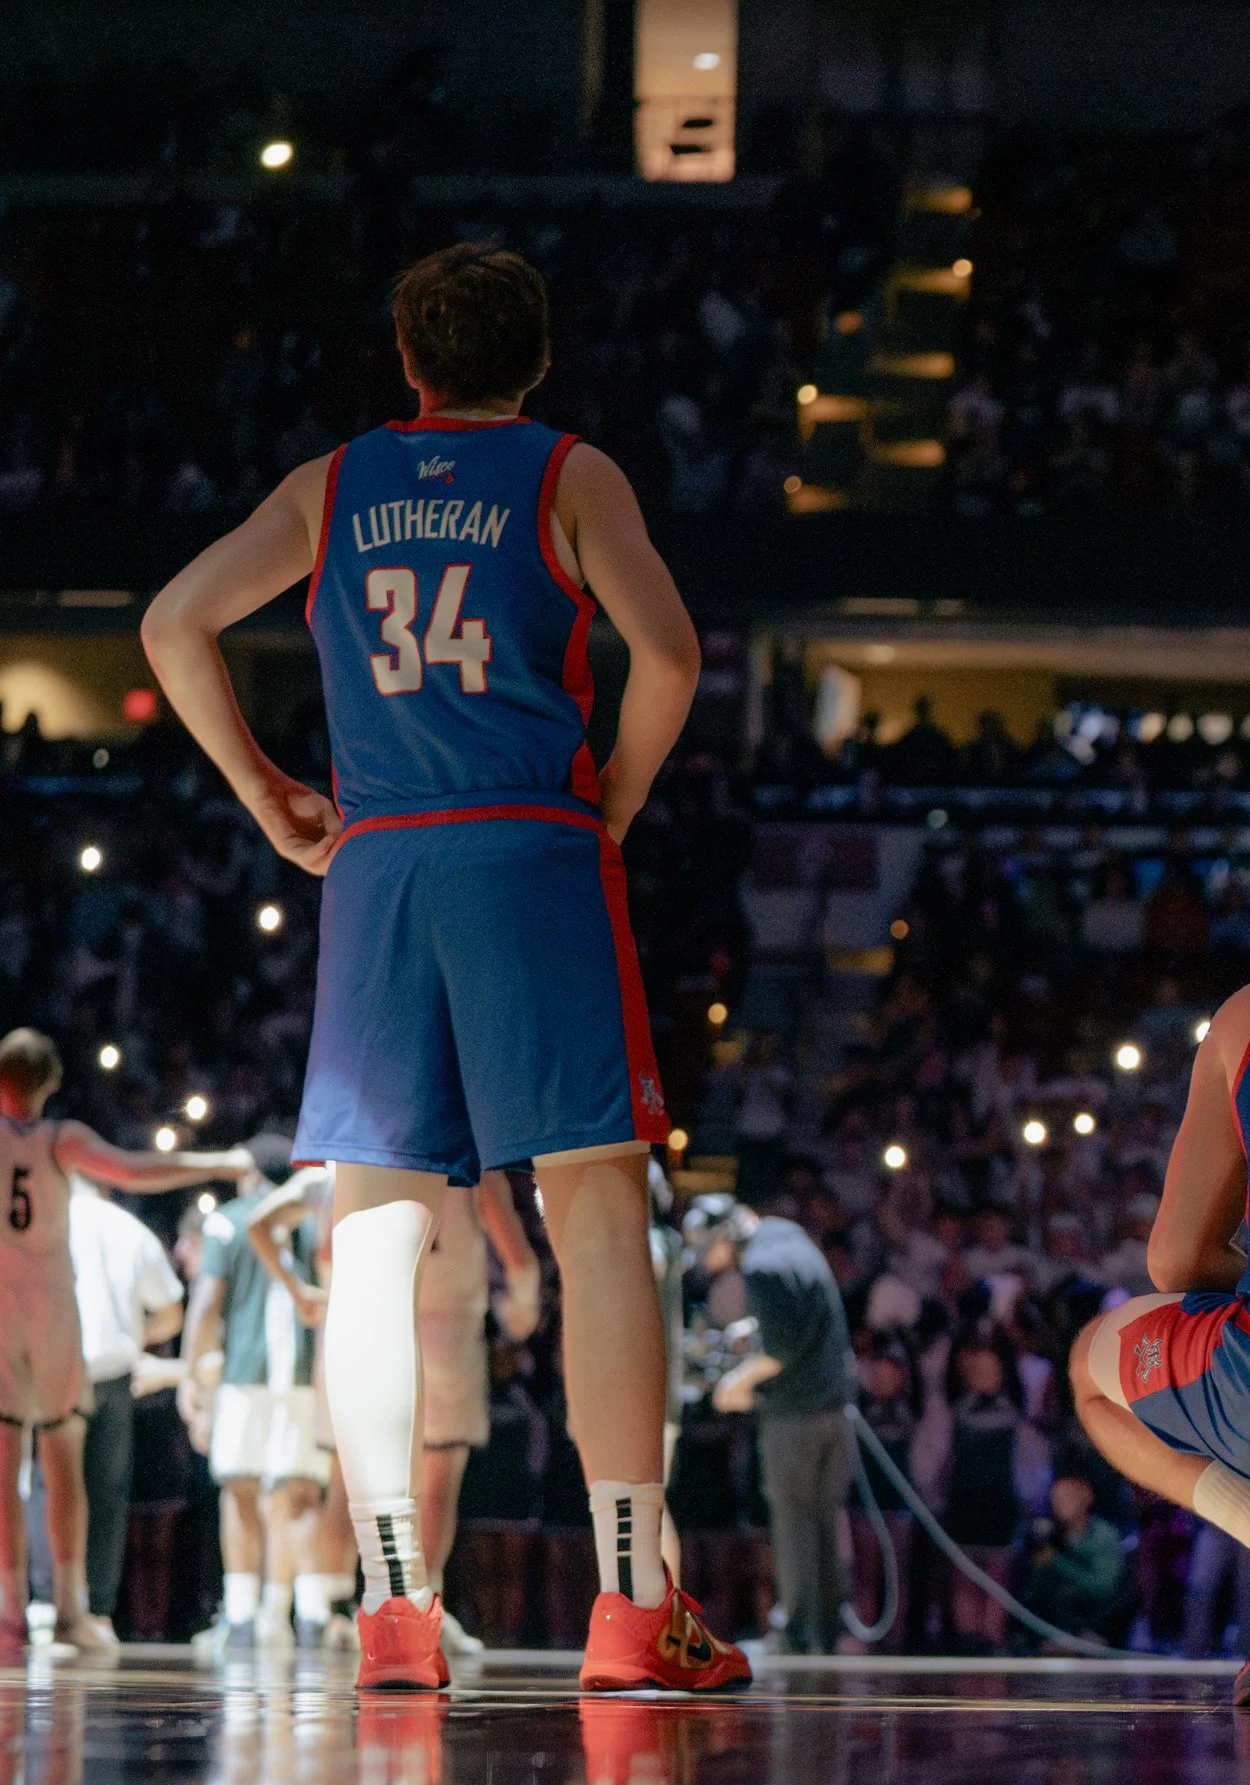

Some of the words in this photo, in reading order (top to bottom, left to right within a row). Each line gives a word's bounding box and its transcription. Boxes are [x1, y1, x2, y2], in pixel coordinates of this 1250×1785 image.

[352, 499, 511, 553] LUTHERAN
[365, 563, 493, 696] 34
[10, 1167, 32, 1232] 5
